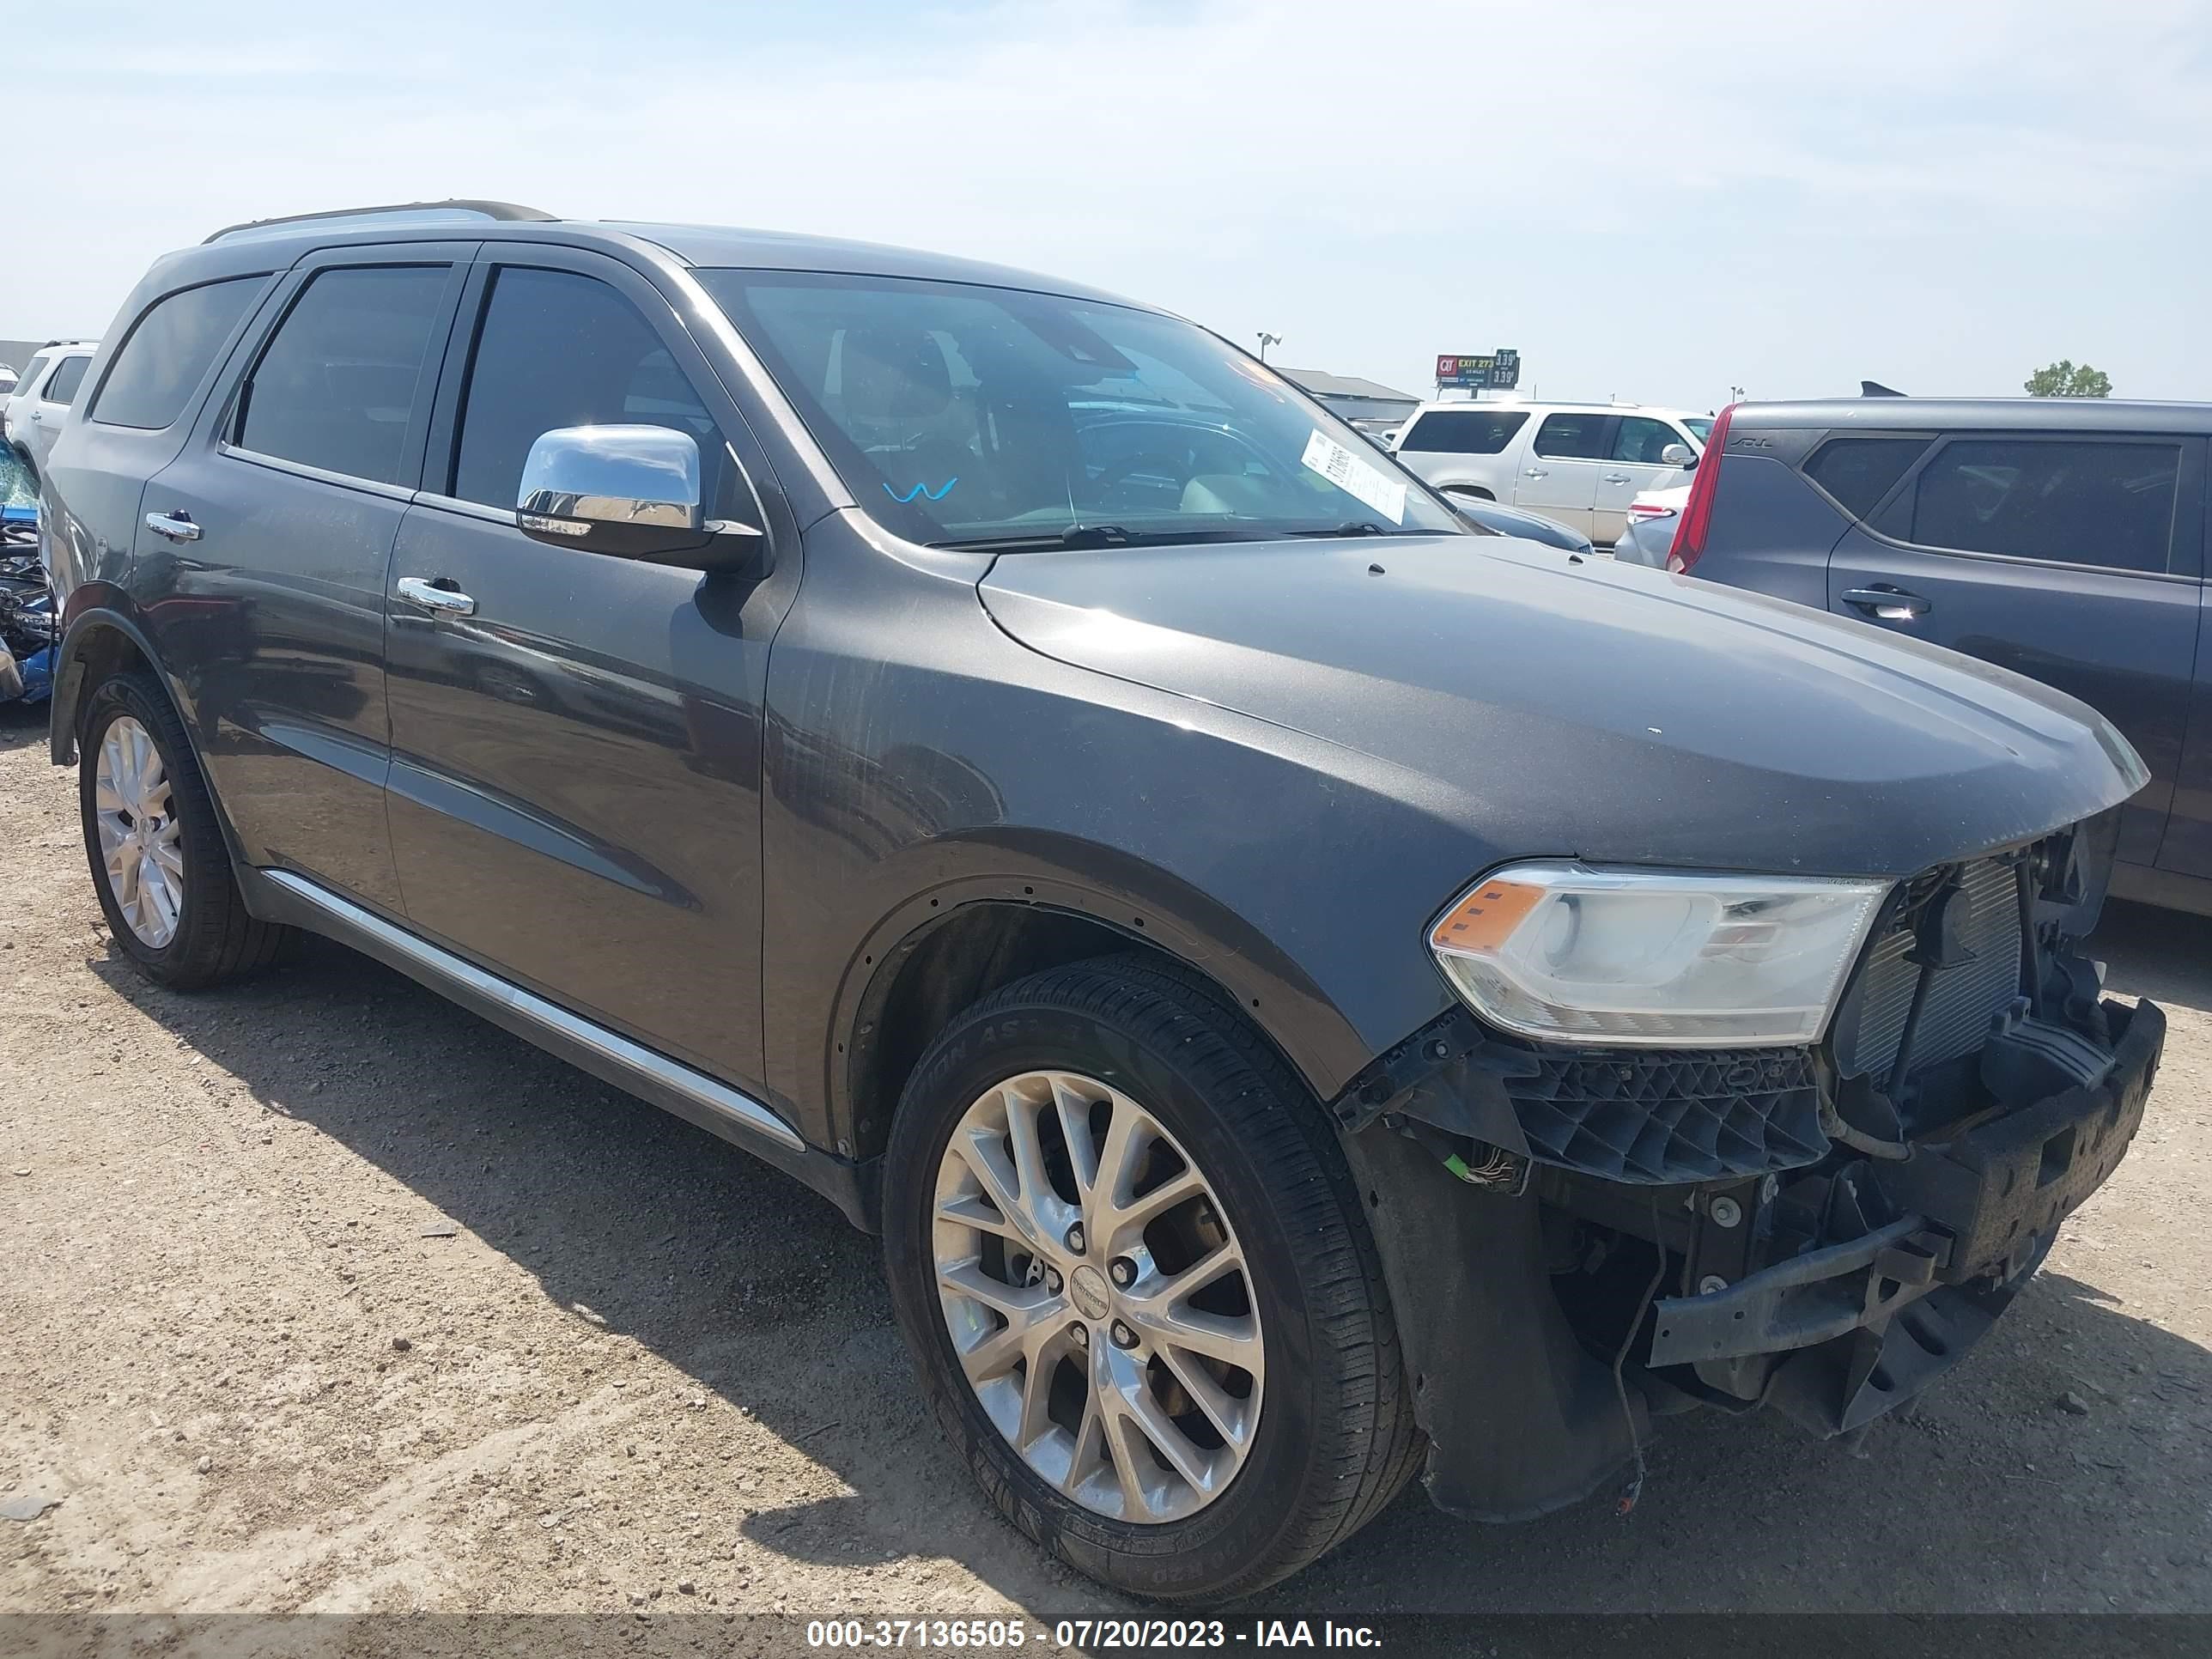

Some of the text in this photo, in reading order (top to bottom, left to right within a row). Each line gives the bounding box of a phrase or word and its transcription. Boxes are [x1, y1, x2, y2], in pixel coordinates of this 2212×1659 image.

[1440, 360, 1454, 372] QT
[1458, 359, 1494, 368] EXIT 273
